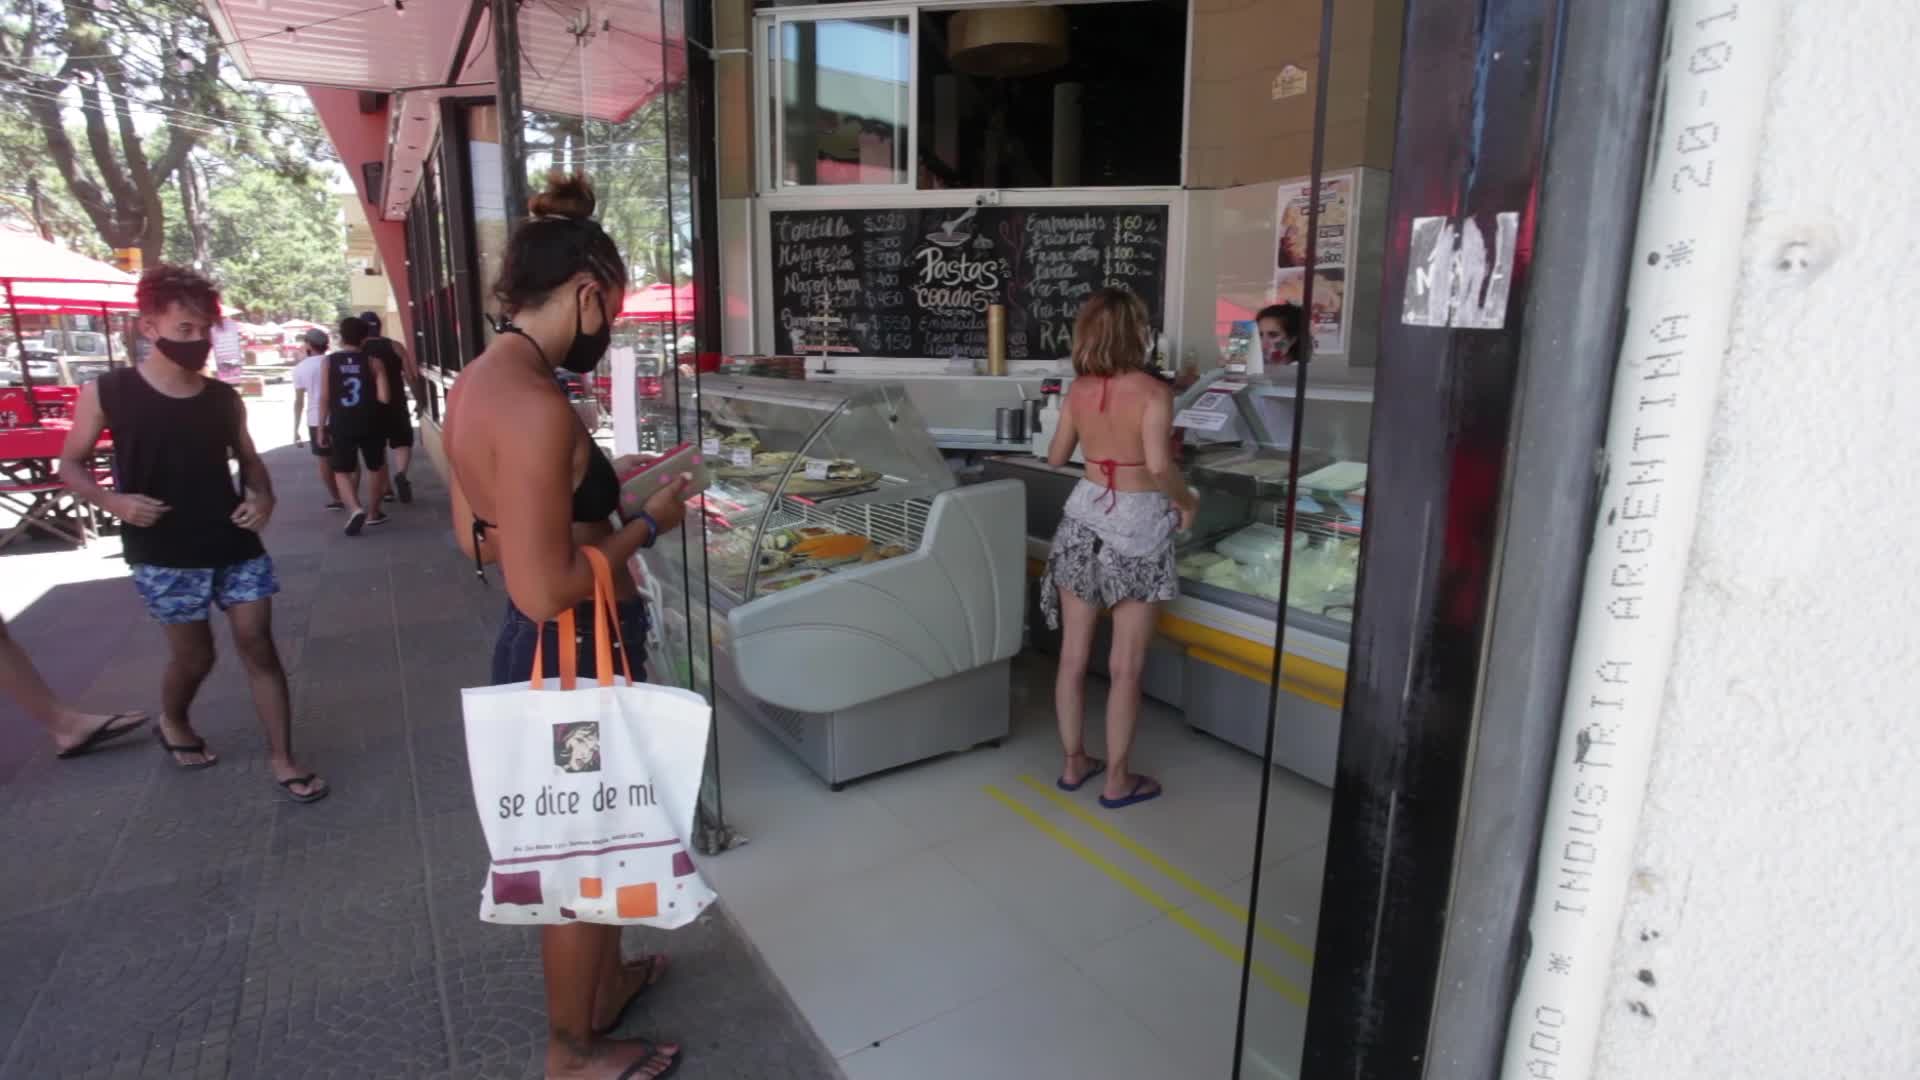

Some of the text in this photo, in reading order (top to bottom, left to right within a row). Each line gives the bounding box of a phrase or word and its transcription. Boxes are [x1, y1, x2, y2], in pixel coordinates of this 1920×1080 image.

[915, 246, 999, 290] Pastas
[340, 376, 362, 407] 3
[1606, 313, 1689, 620] ARGENTINA
[499, 794, 525, 819] se
[535, 785, 580, 816] dice
[592, 782, 618, 813] de
[1553, 659, 1633, 918] INDUSTRIA
